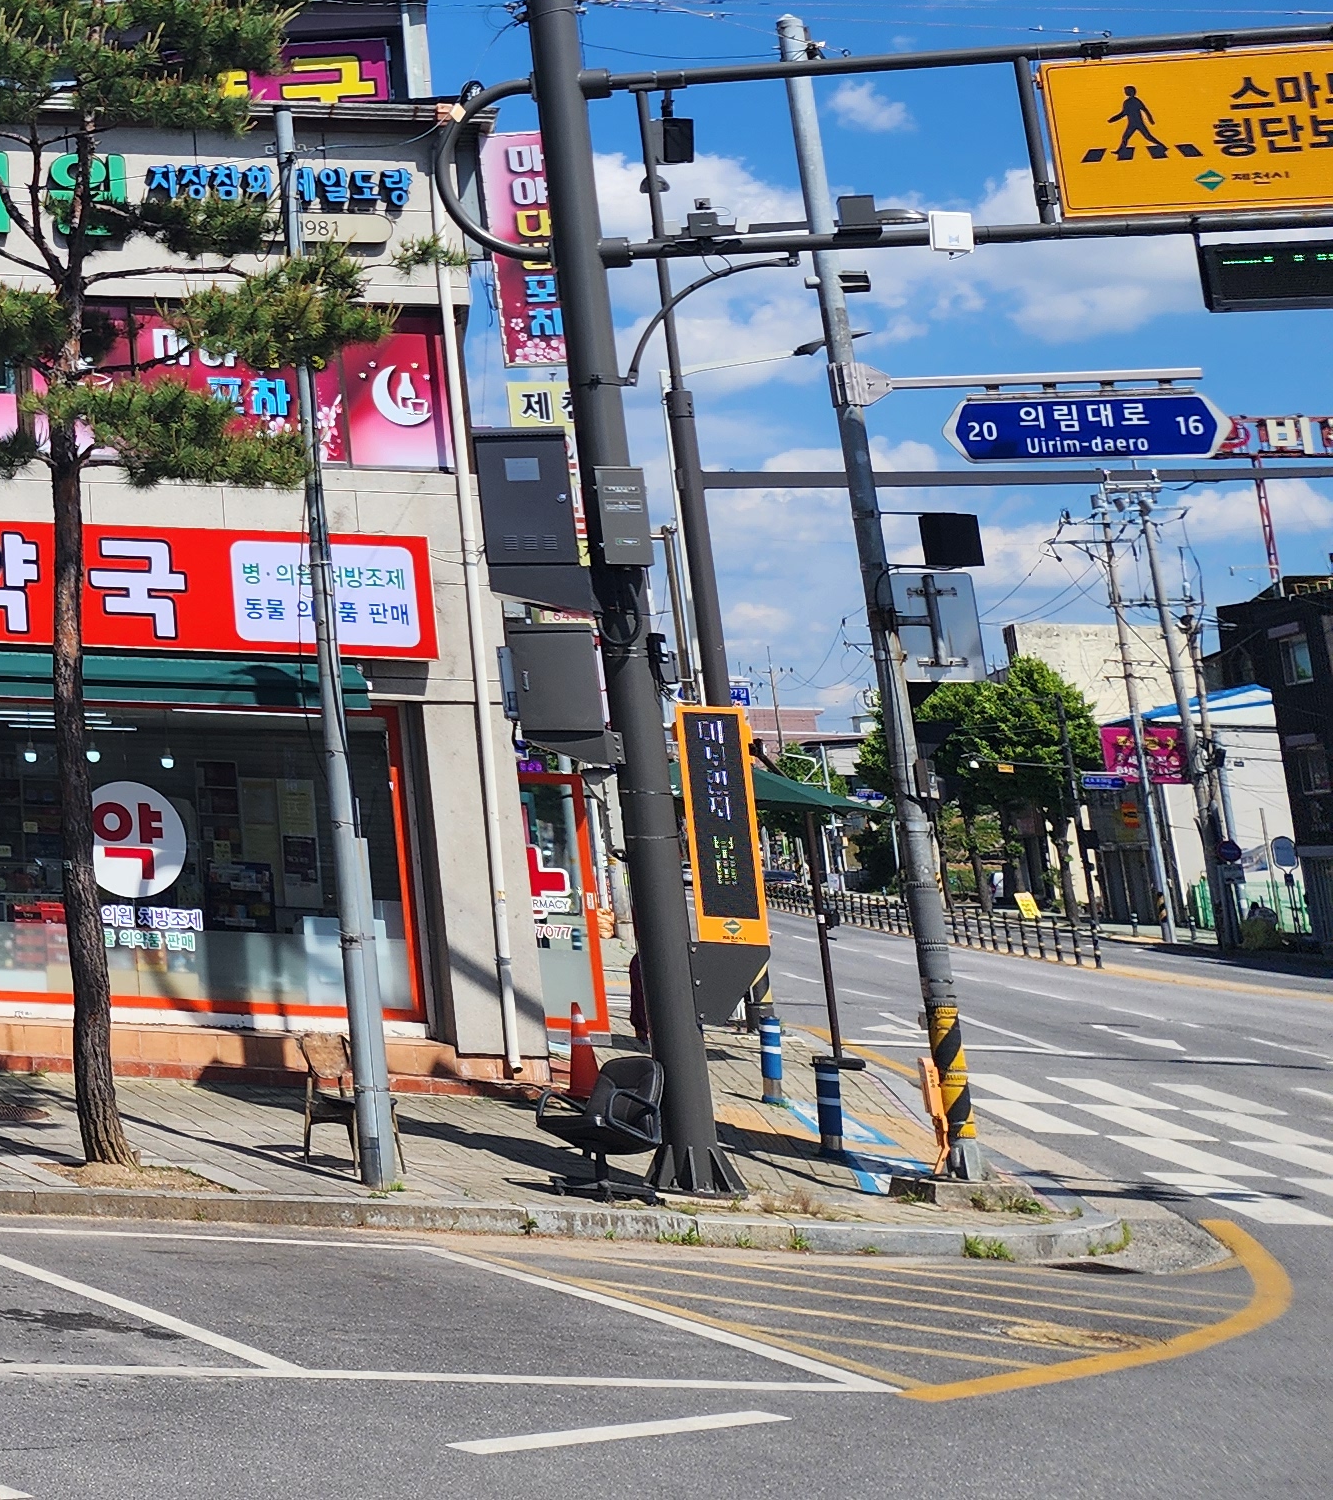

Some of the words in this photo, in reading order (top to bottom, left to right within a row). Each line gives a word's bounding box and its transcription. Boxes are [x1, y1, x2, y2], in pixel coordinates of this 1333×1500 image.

[1230, 71, 1333, 111] 스마
[149, 164, 273, 201] 지장참회
[1231, 171, 1290, 185] 제천시
[967, 421, 998, 441] 20
[1019, 403, 1150, 429] 의림대로
[1175, 416, 1204, 436] 16
[1026, 435, 1149, 455] Uirim-daero
[244, 598, 286, 621] 동물
[297, 600, 359, 624] 의품
[368, 602, 410, 626] 판매
[92, 801, 164, 880] 약
[138, 906, 204, 932] 처방조제
[119, 929, 163, 950] 의약품
[165, 931, 196, 952] 판매
